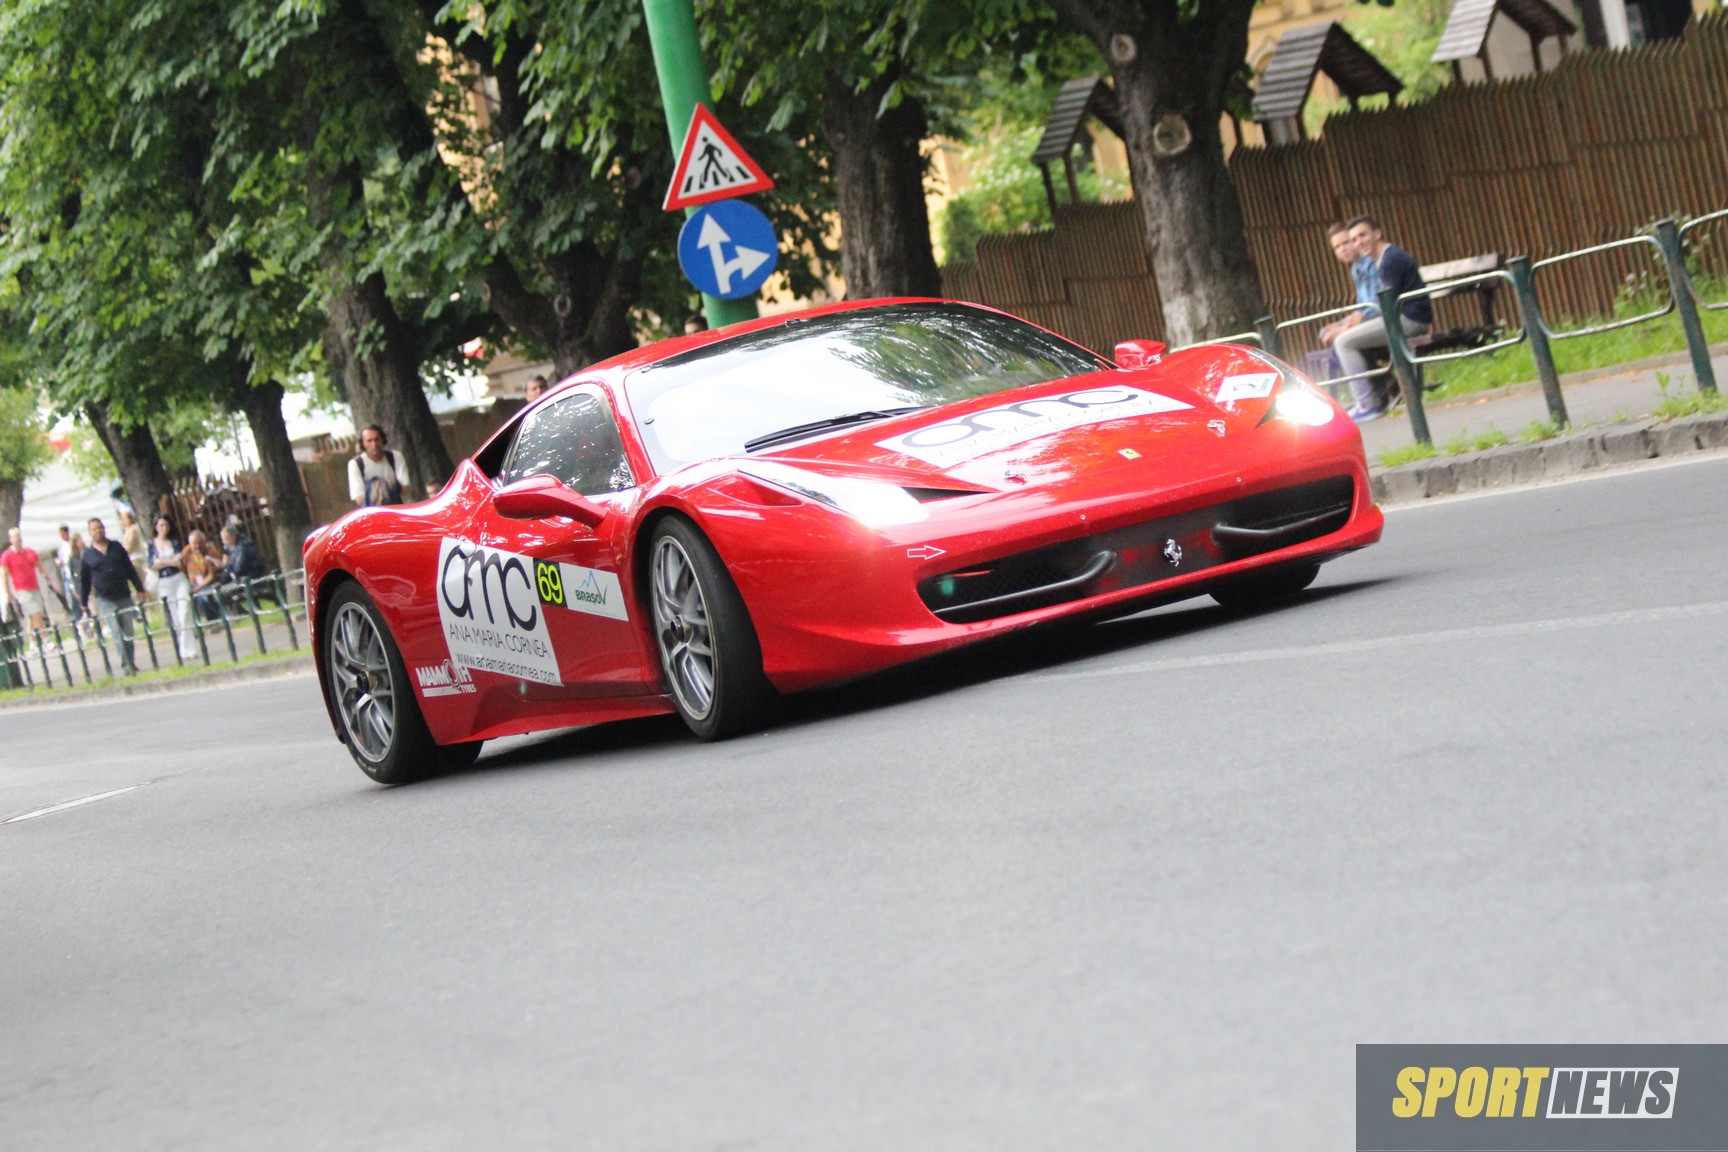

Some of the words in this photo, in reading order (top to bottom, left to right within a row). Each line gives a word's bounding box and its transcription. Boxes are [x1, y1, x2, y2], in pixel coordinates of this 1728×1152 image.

[537, 562, 563, 604] 69
[450, 623, 474, 643] ANA
[472, 628, 504, 649] MARIA
[505, 634, 550, 658] CORNEA
